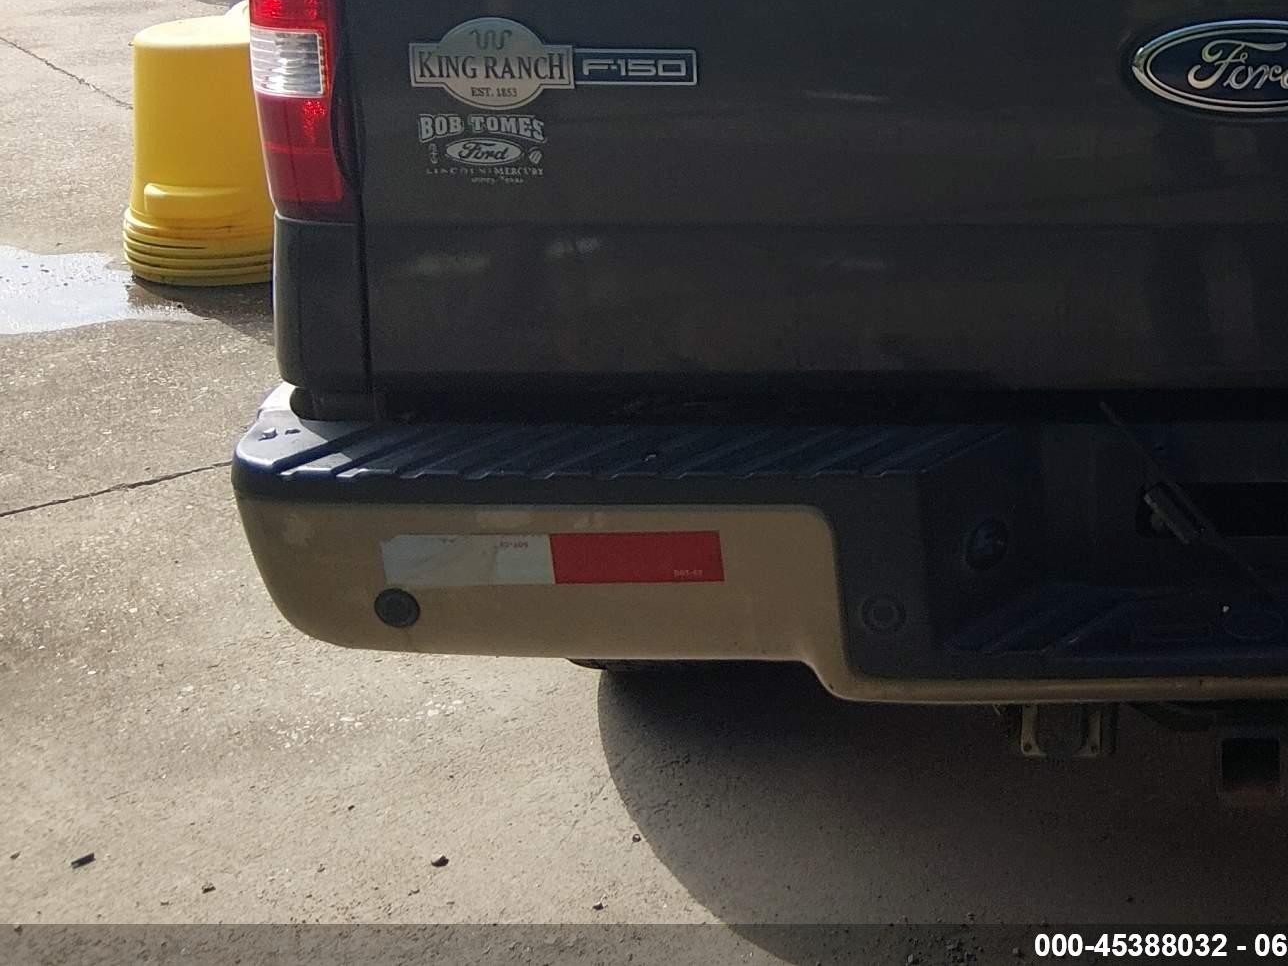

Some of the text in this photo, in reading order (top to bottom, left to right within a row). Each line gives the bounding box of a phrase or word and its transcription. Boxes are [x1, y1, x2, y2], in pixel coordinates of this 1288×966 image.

[418, 51, 565, 80] KING RANCH
[471, 86, 493, 98] EST.
[418, 114, 546, 143] BOB TOMES
[458, 141, 510, 160] Ford
